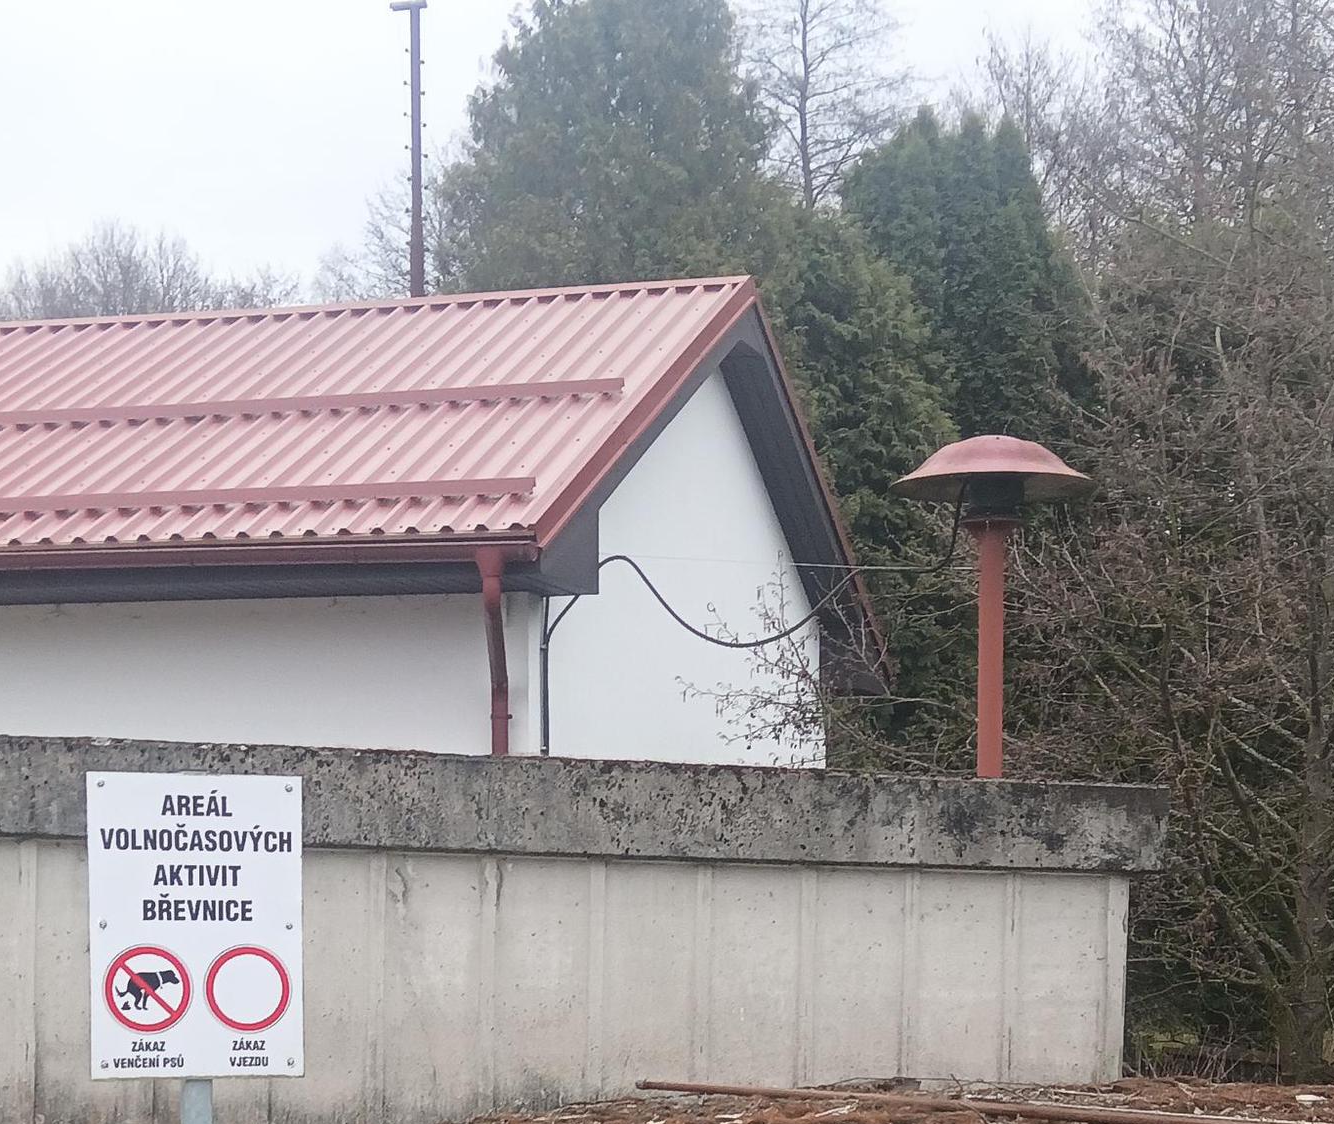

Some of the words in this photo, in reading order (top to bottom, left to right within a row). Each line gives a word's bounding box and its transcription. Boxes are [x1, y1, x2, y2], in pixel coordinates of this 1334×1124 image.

[161, 789, 232, 817] AREÁL
[100, 823, 293, 852] VOLNOČASOVÝCH
[153, 864, 241, 886] AKTIVIT
[142, 893, 253, 921] BŘEVNICE
[131, 1037, 166, 1052] ZÁKAZ
[232, 1037, 266, 1051] ZÁKAZ
[113, 1054, 160, 1068] VENČENÍ
[229, 1056, 269, 1068] VJEZDU
